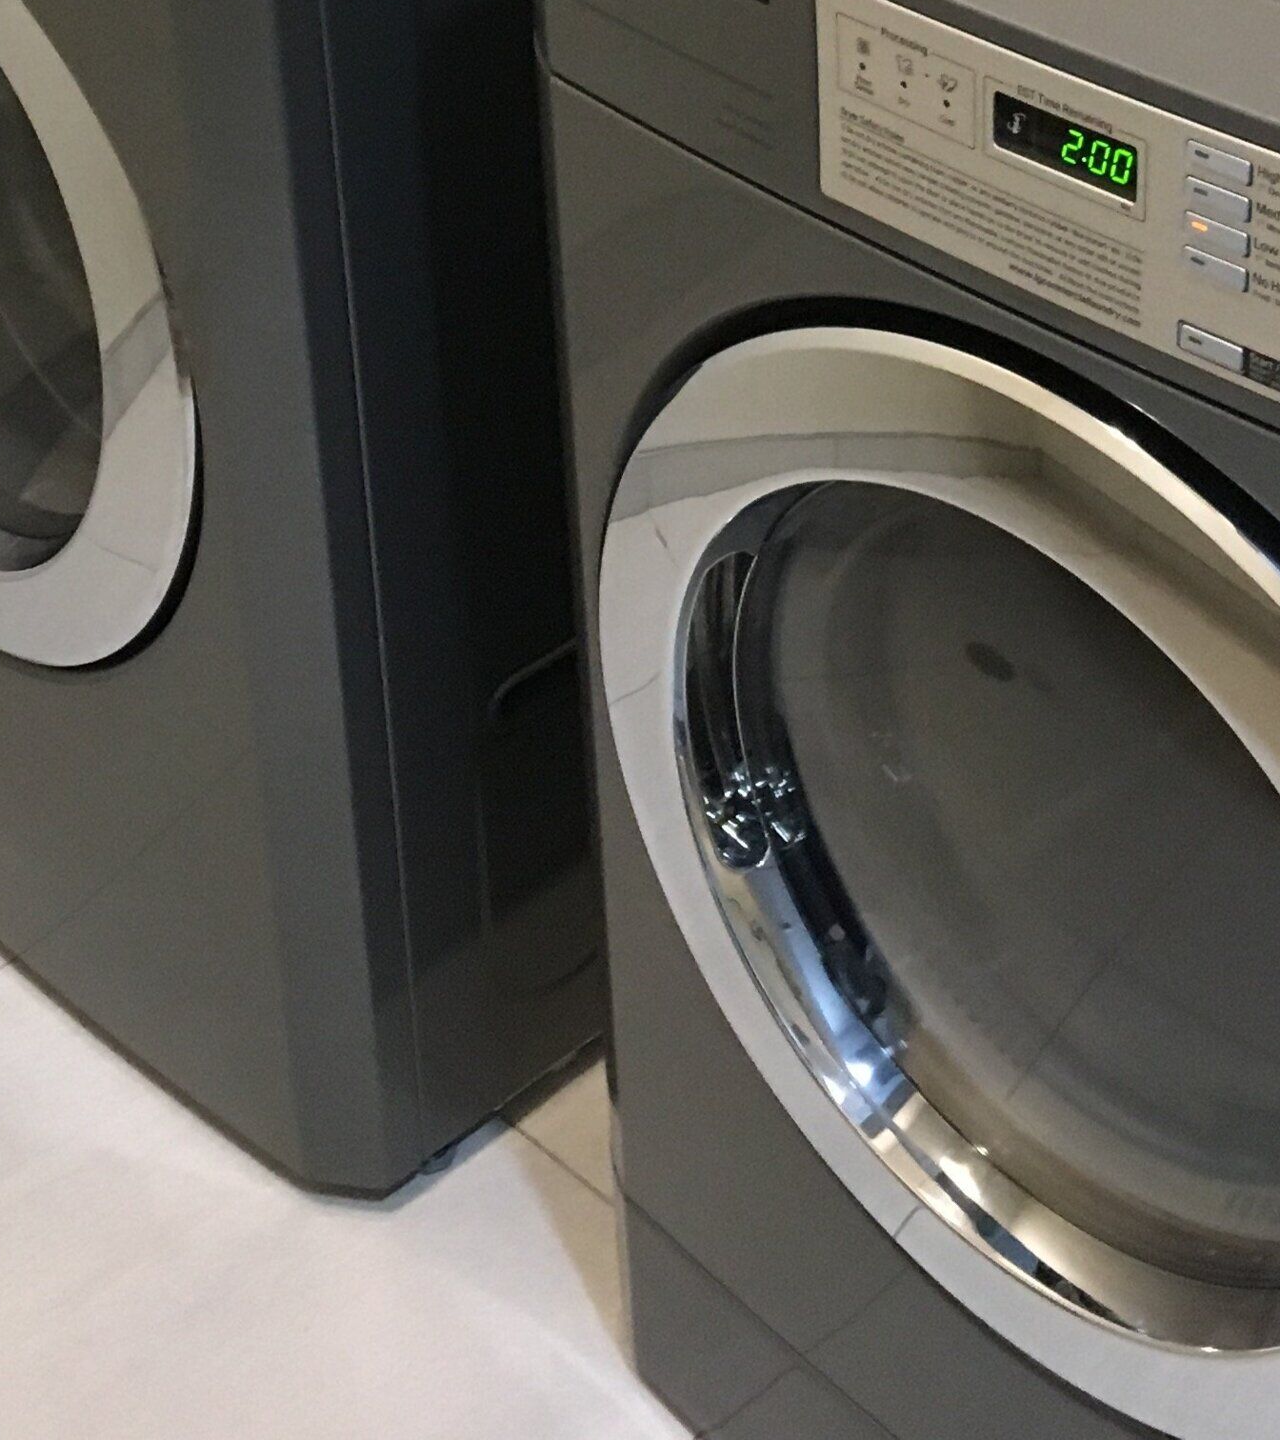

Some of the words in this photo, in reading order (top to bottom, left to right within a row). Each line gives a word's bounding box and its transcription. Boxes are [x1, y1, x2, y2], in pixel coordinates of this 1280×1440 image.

[1256, 202, 1280, 221] Med
[1254, 237, 1279, 257] Low
[1253, 272, 1269, 289] No
